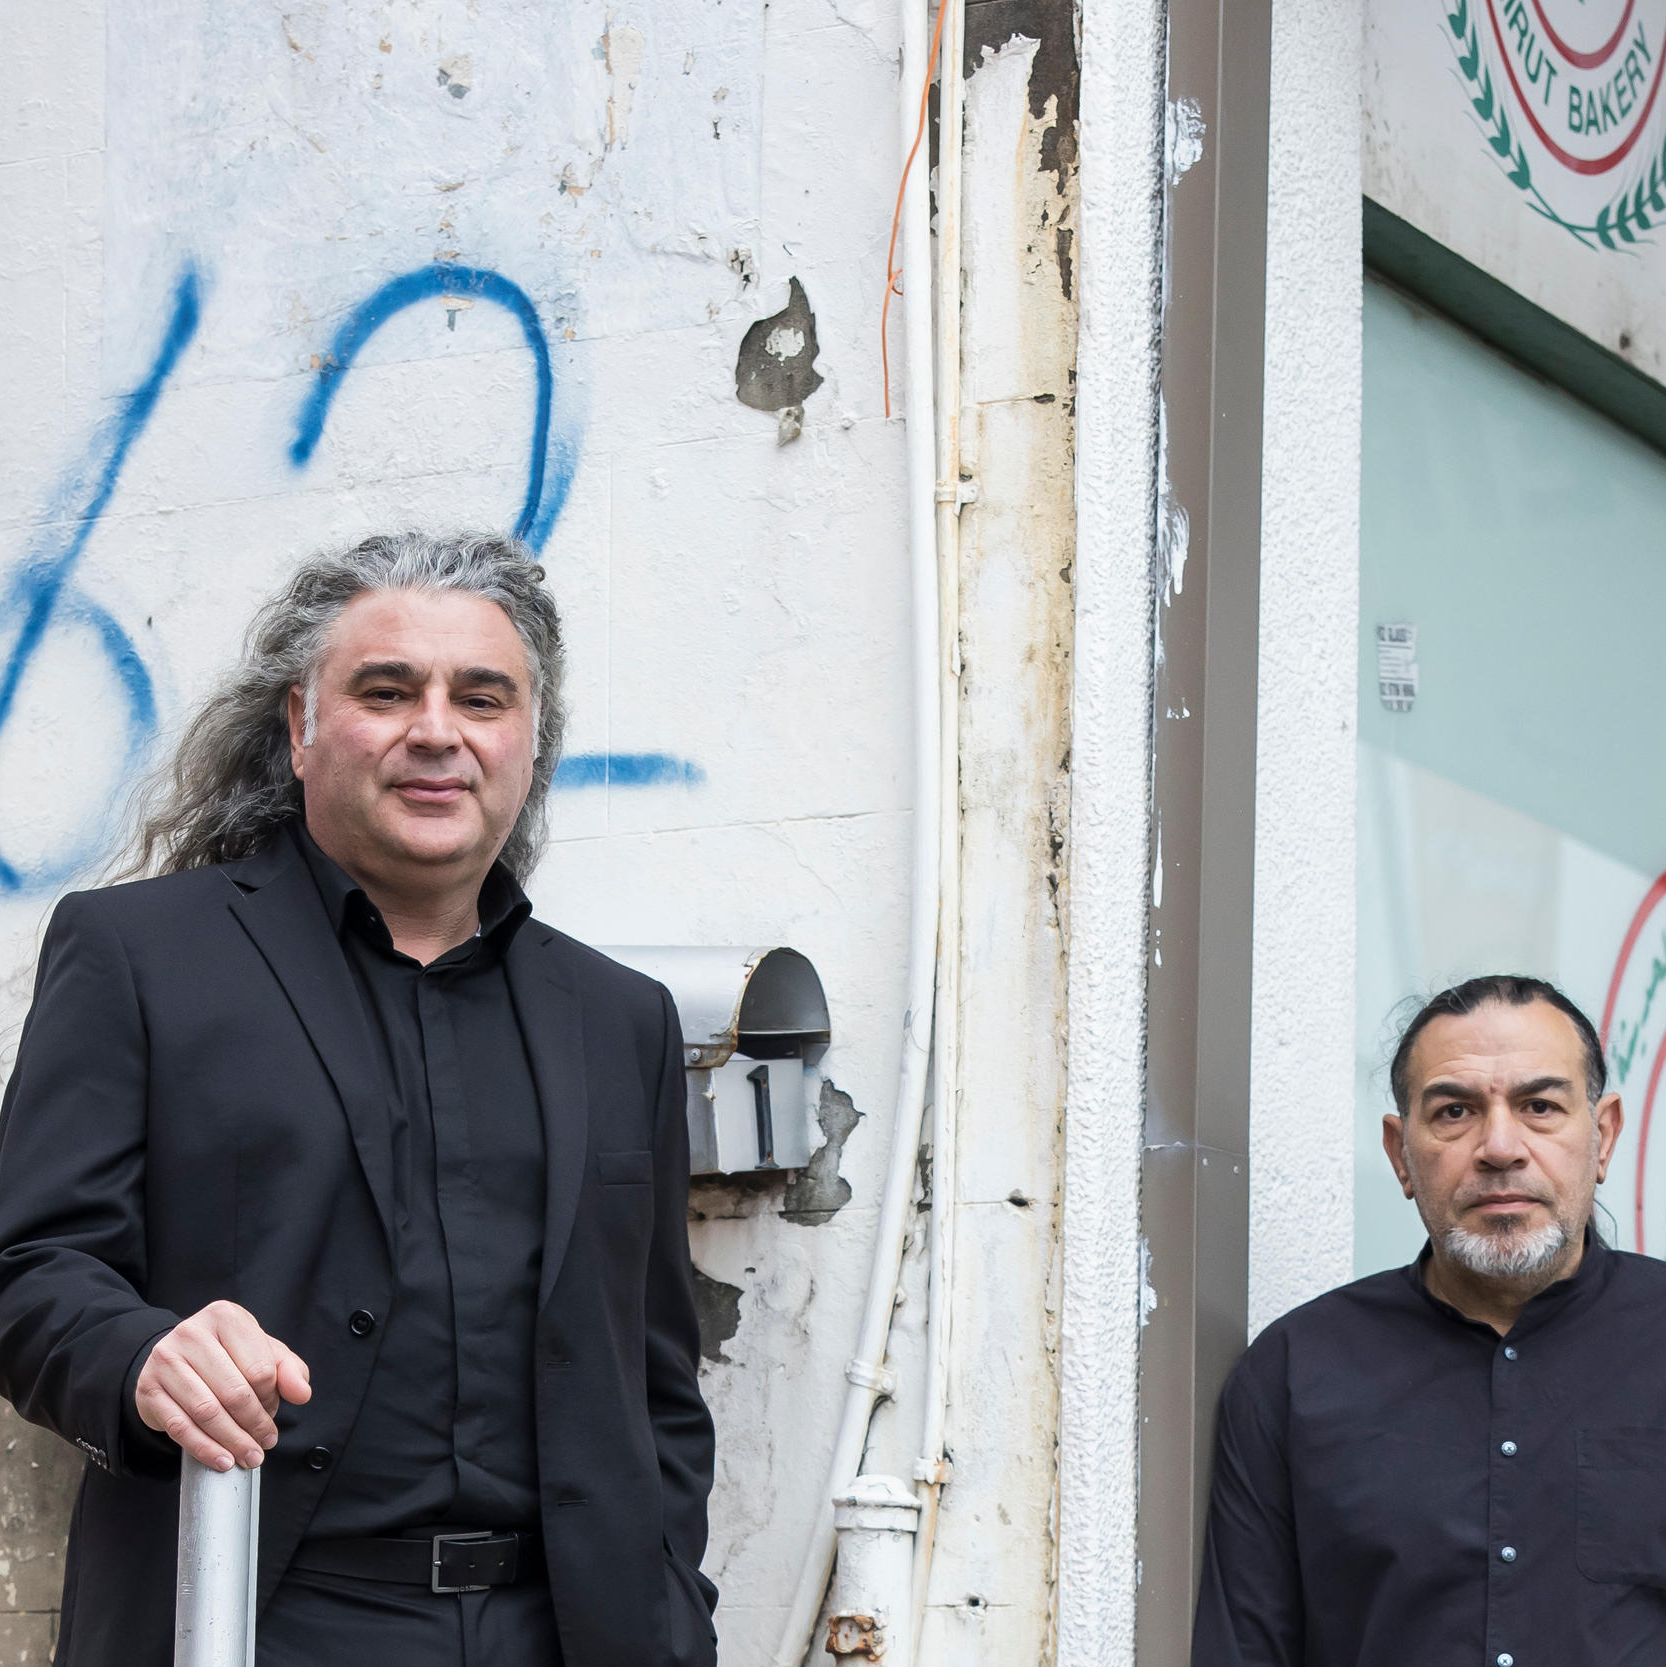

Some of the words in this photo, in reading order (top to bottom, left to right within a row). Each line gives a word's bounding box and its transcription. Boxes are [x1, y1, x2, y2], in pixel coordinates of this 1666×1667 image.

[1501, 0, 1558, 106] IRUT
[1568, 20, 1652, 136] BAKERY
[746, 1064, 780, 1169] 1
